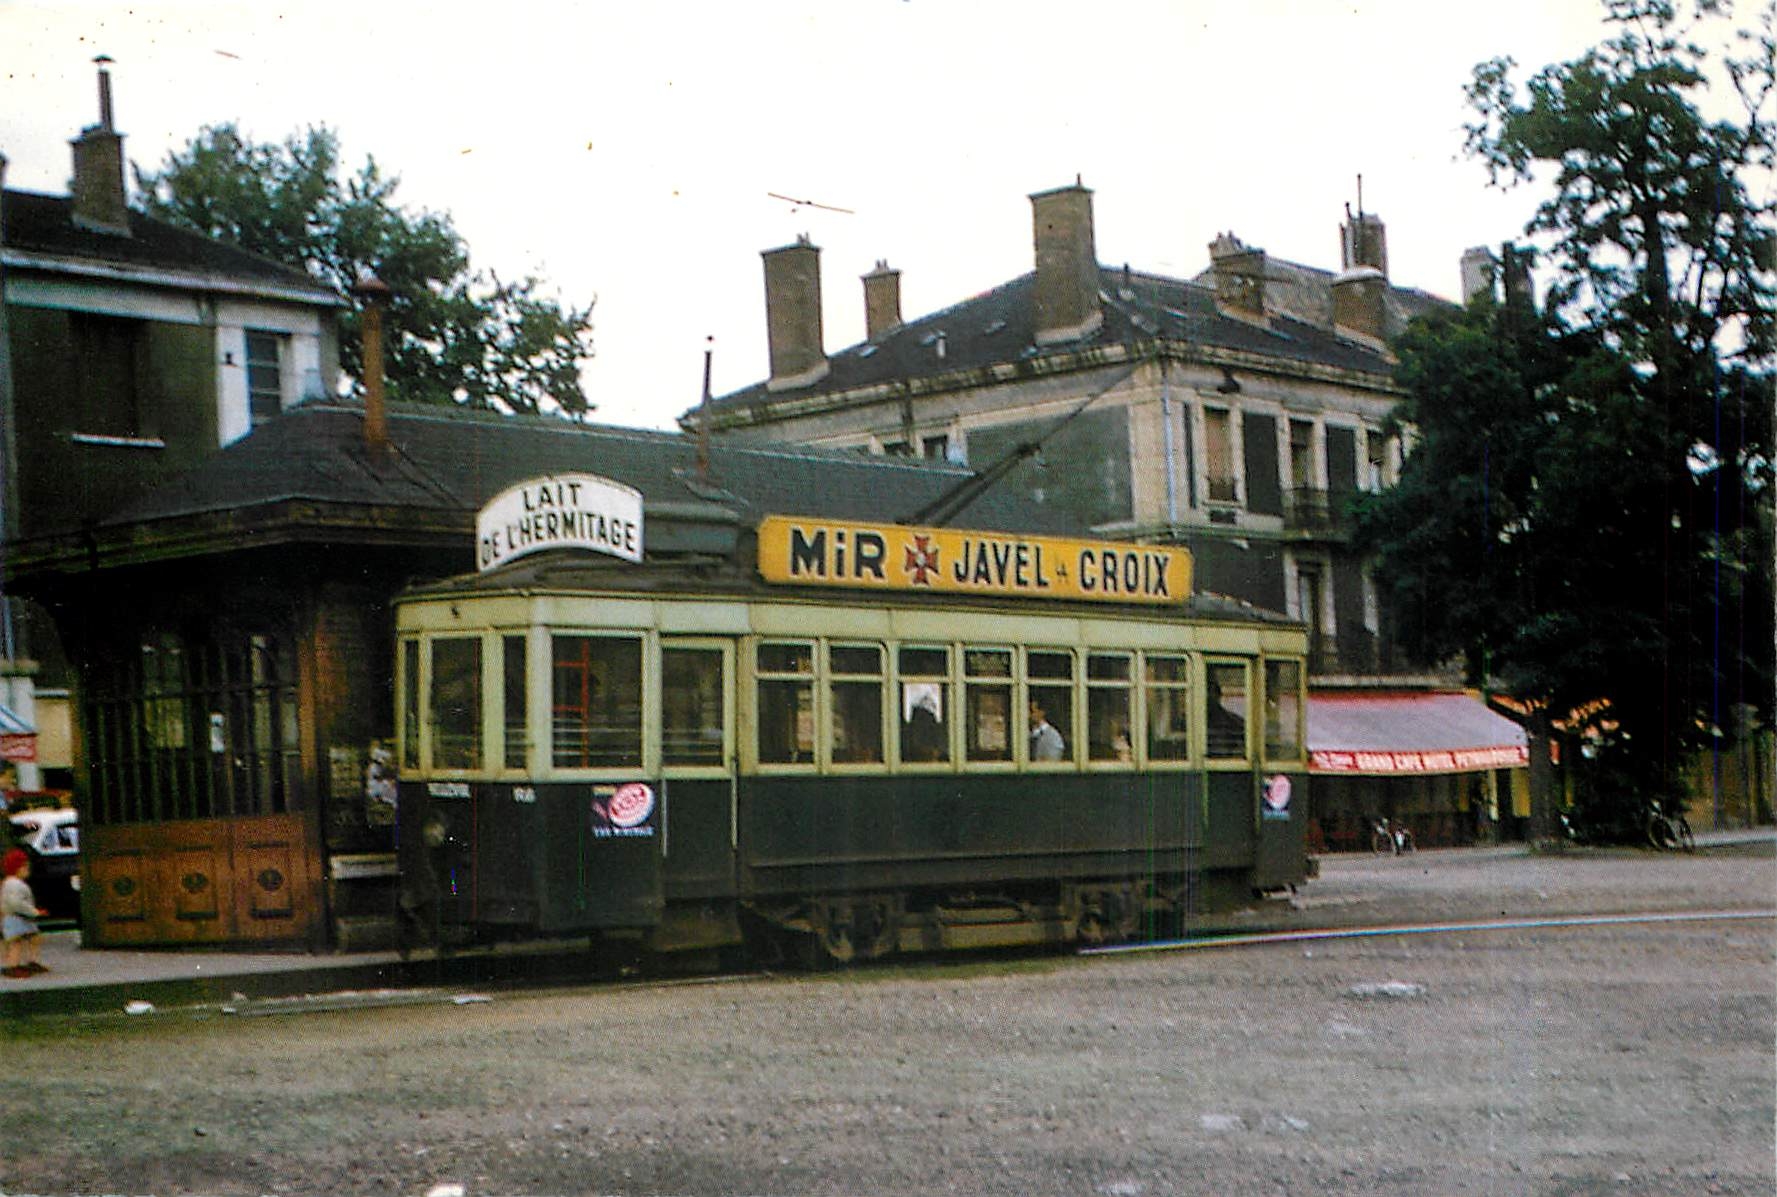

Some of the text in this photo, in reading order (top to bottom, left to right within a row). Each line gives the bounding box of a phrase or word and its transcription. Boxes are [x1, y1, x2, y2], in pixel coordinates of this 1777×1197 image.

[521, 481, 582, 512] LAIT
[480, 531, 501, 565] DE
[953, 539, 1050, 588] JAVEL
[1078, 549, 1171, 597] CROIX
